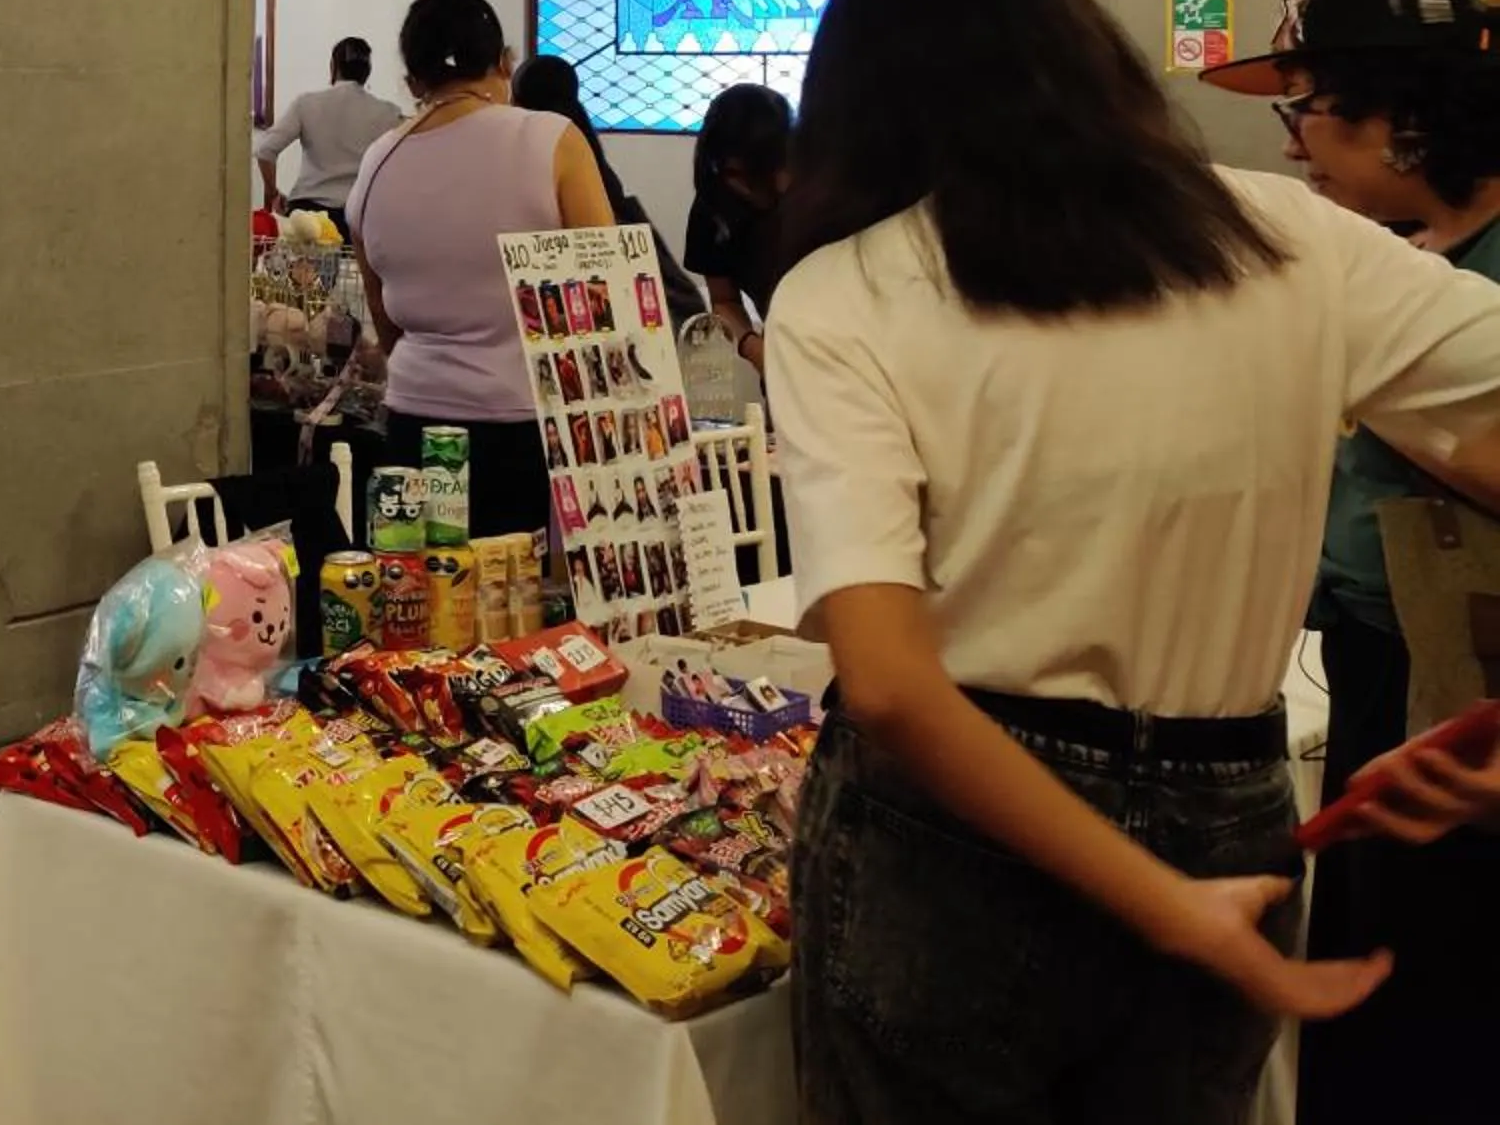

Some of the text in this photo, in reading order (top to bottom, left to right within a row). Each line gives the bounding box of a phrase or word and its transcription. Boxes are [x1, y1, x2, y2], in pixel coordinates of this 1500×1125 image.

[532, 234, 569, 254] Juego
[618, 229, 649, 263] $10
[635, 878, 708, 930] Samyan
